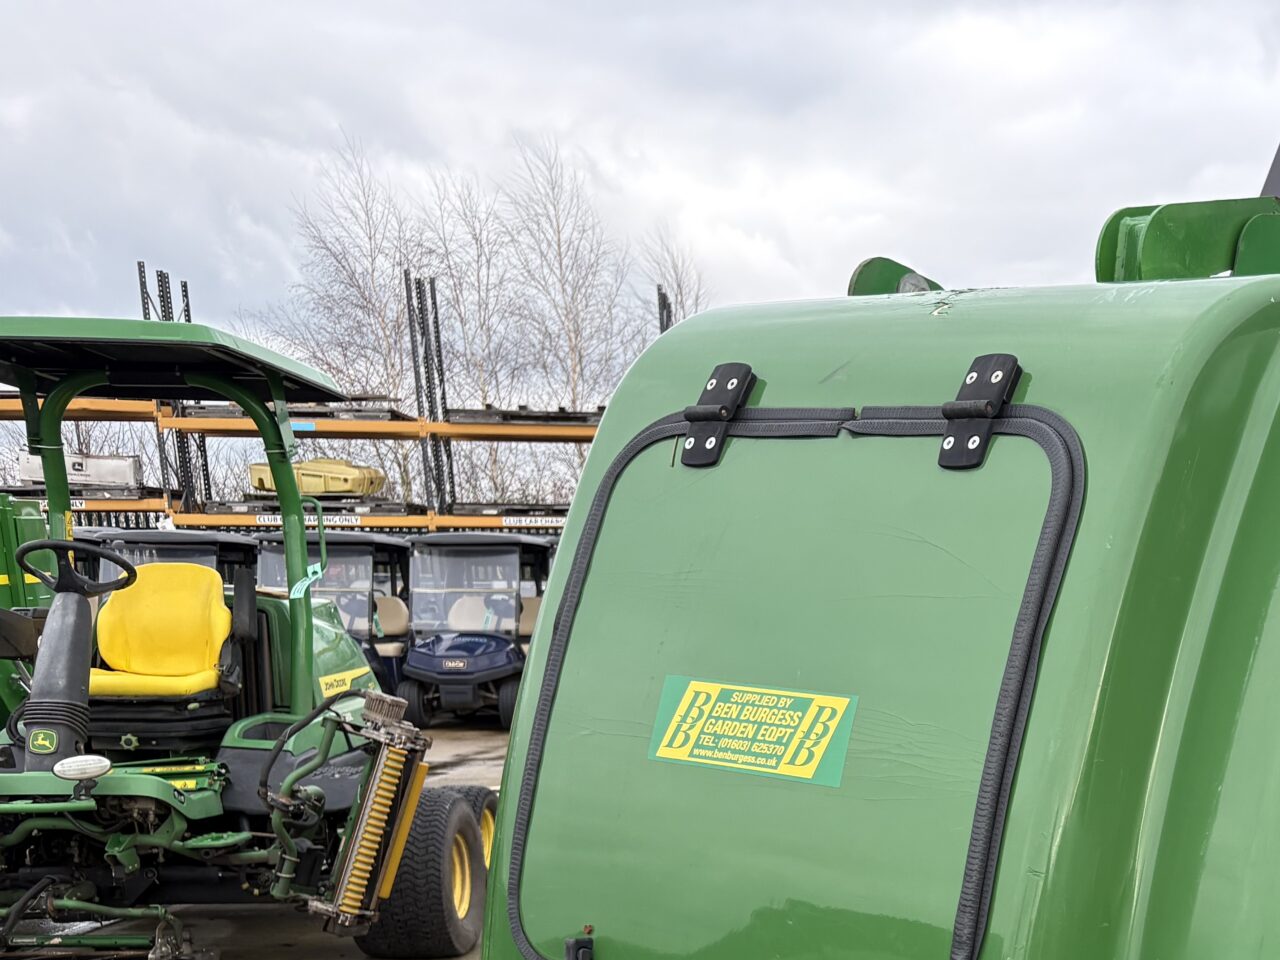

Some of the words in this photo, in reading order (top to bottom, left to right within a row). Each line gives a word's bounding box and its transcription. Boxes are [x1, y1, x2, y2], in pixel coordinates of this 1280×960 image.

[338, 516, 359, 525] ONLY
[731, 692, 778, 707] SUPPLIED
[777, 697, 794, 708] BY
[712, 702, 741, 719] BEN
[740, 705, 802, 727] BURGESS
[703, 718, 758, 739] GARDEN
[757, 725, 795, 743] EQPT
[699, 735, 719, 747] TEL:
[718, 737, 752, 752] (01603)
[751, 742, 785, 756] 625370
[693, 748, 777, 766] www.benburgess.co.uk
